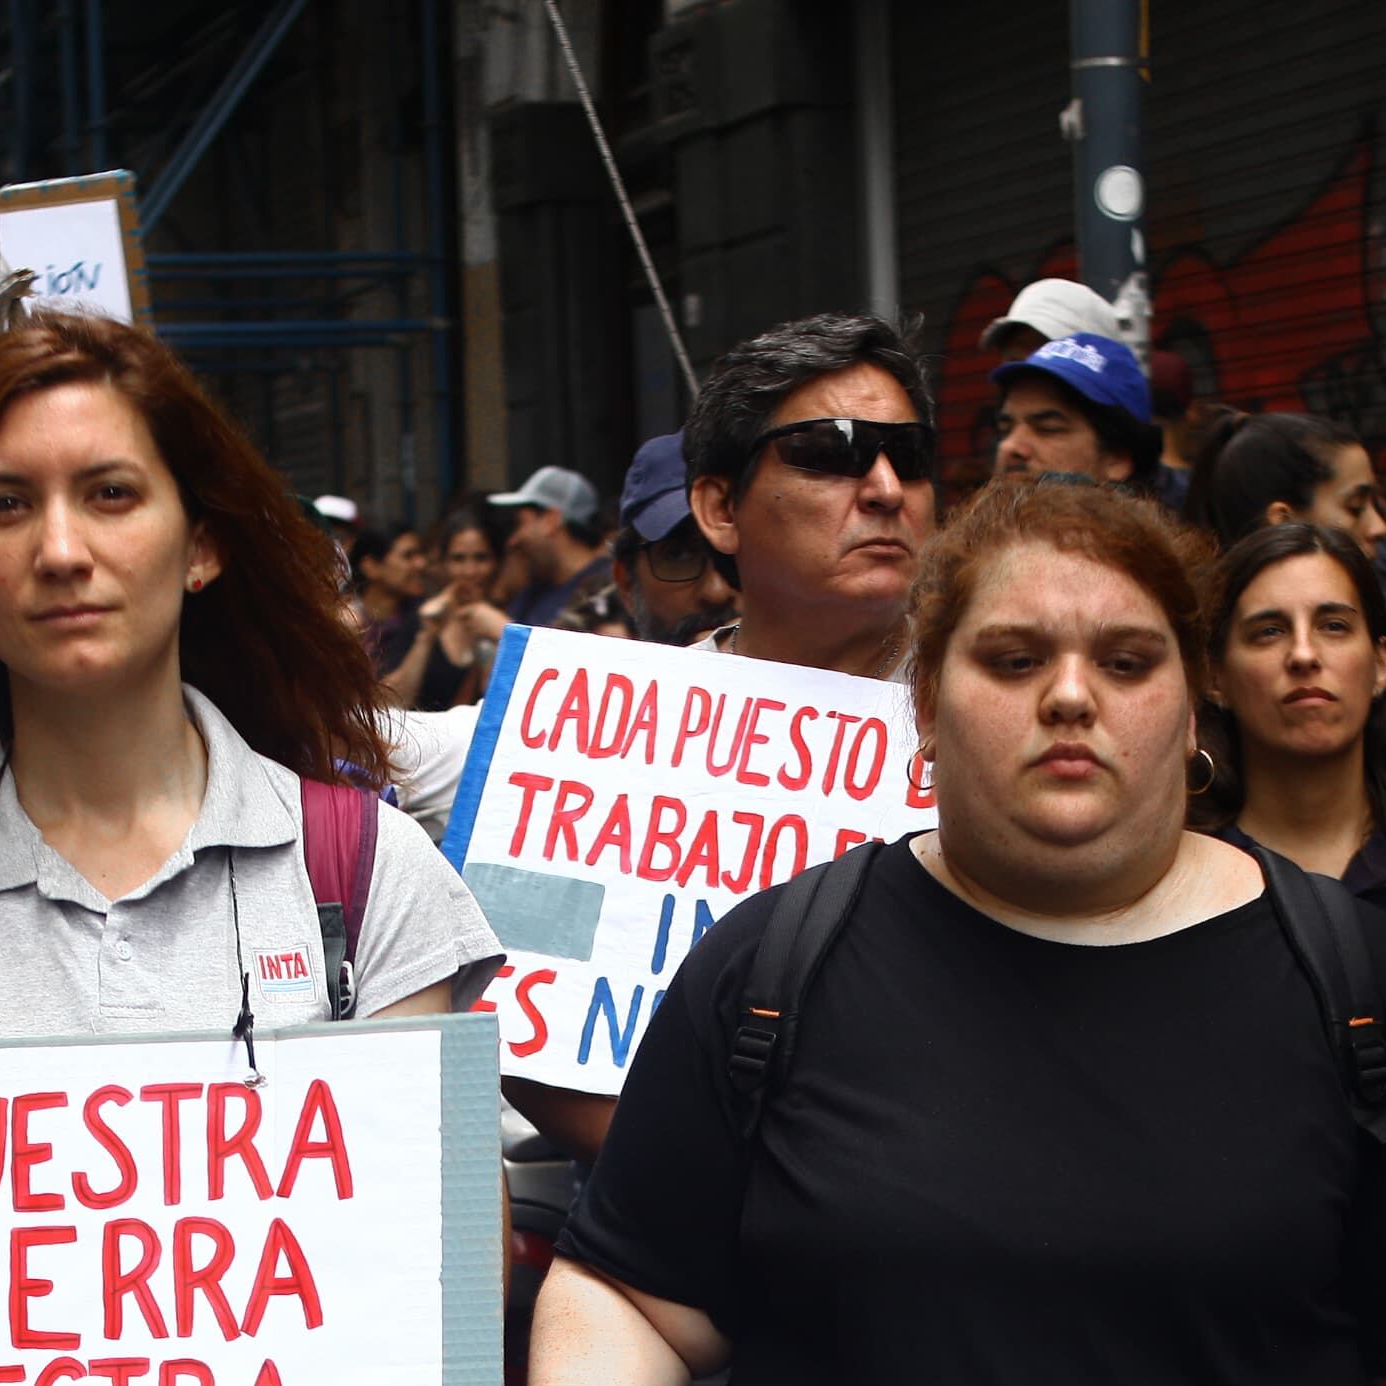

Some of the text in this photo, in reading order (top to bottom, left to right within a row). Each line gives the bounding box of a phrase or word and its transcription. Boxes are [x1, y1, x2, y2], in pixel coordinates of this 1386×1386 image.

[520, 667, 659, 766] CADA
[671, 685, 889, 801] PUESTO
[508, 771, 808, 895] TRABAJO
[258, 951, 310, 980] INTA
